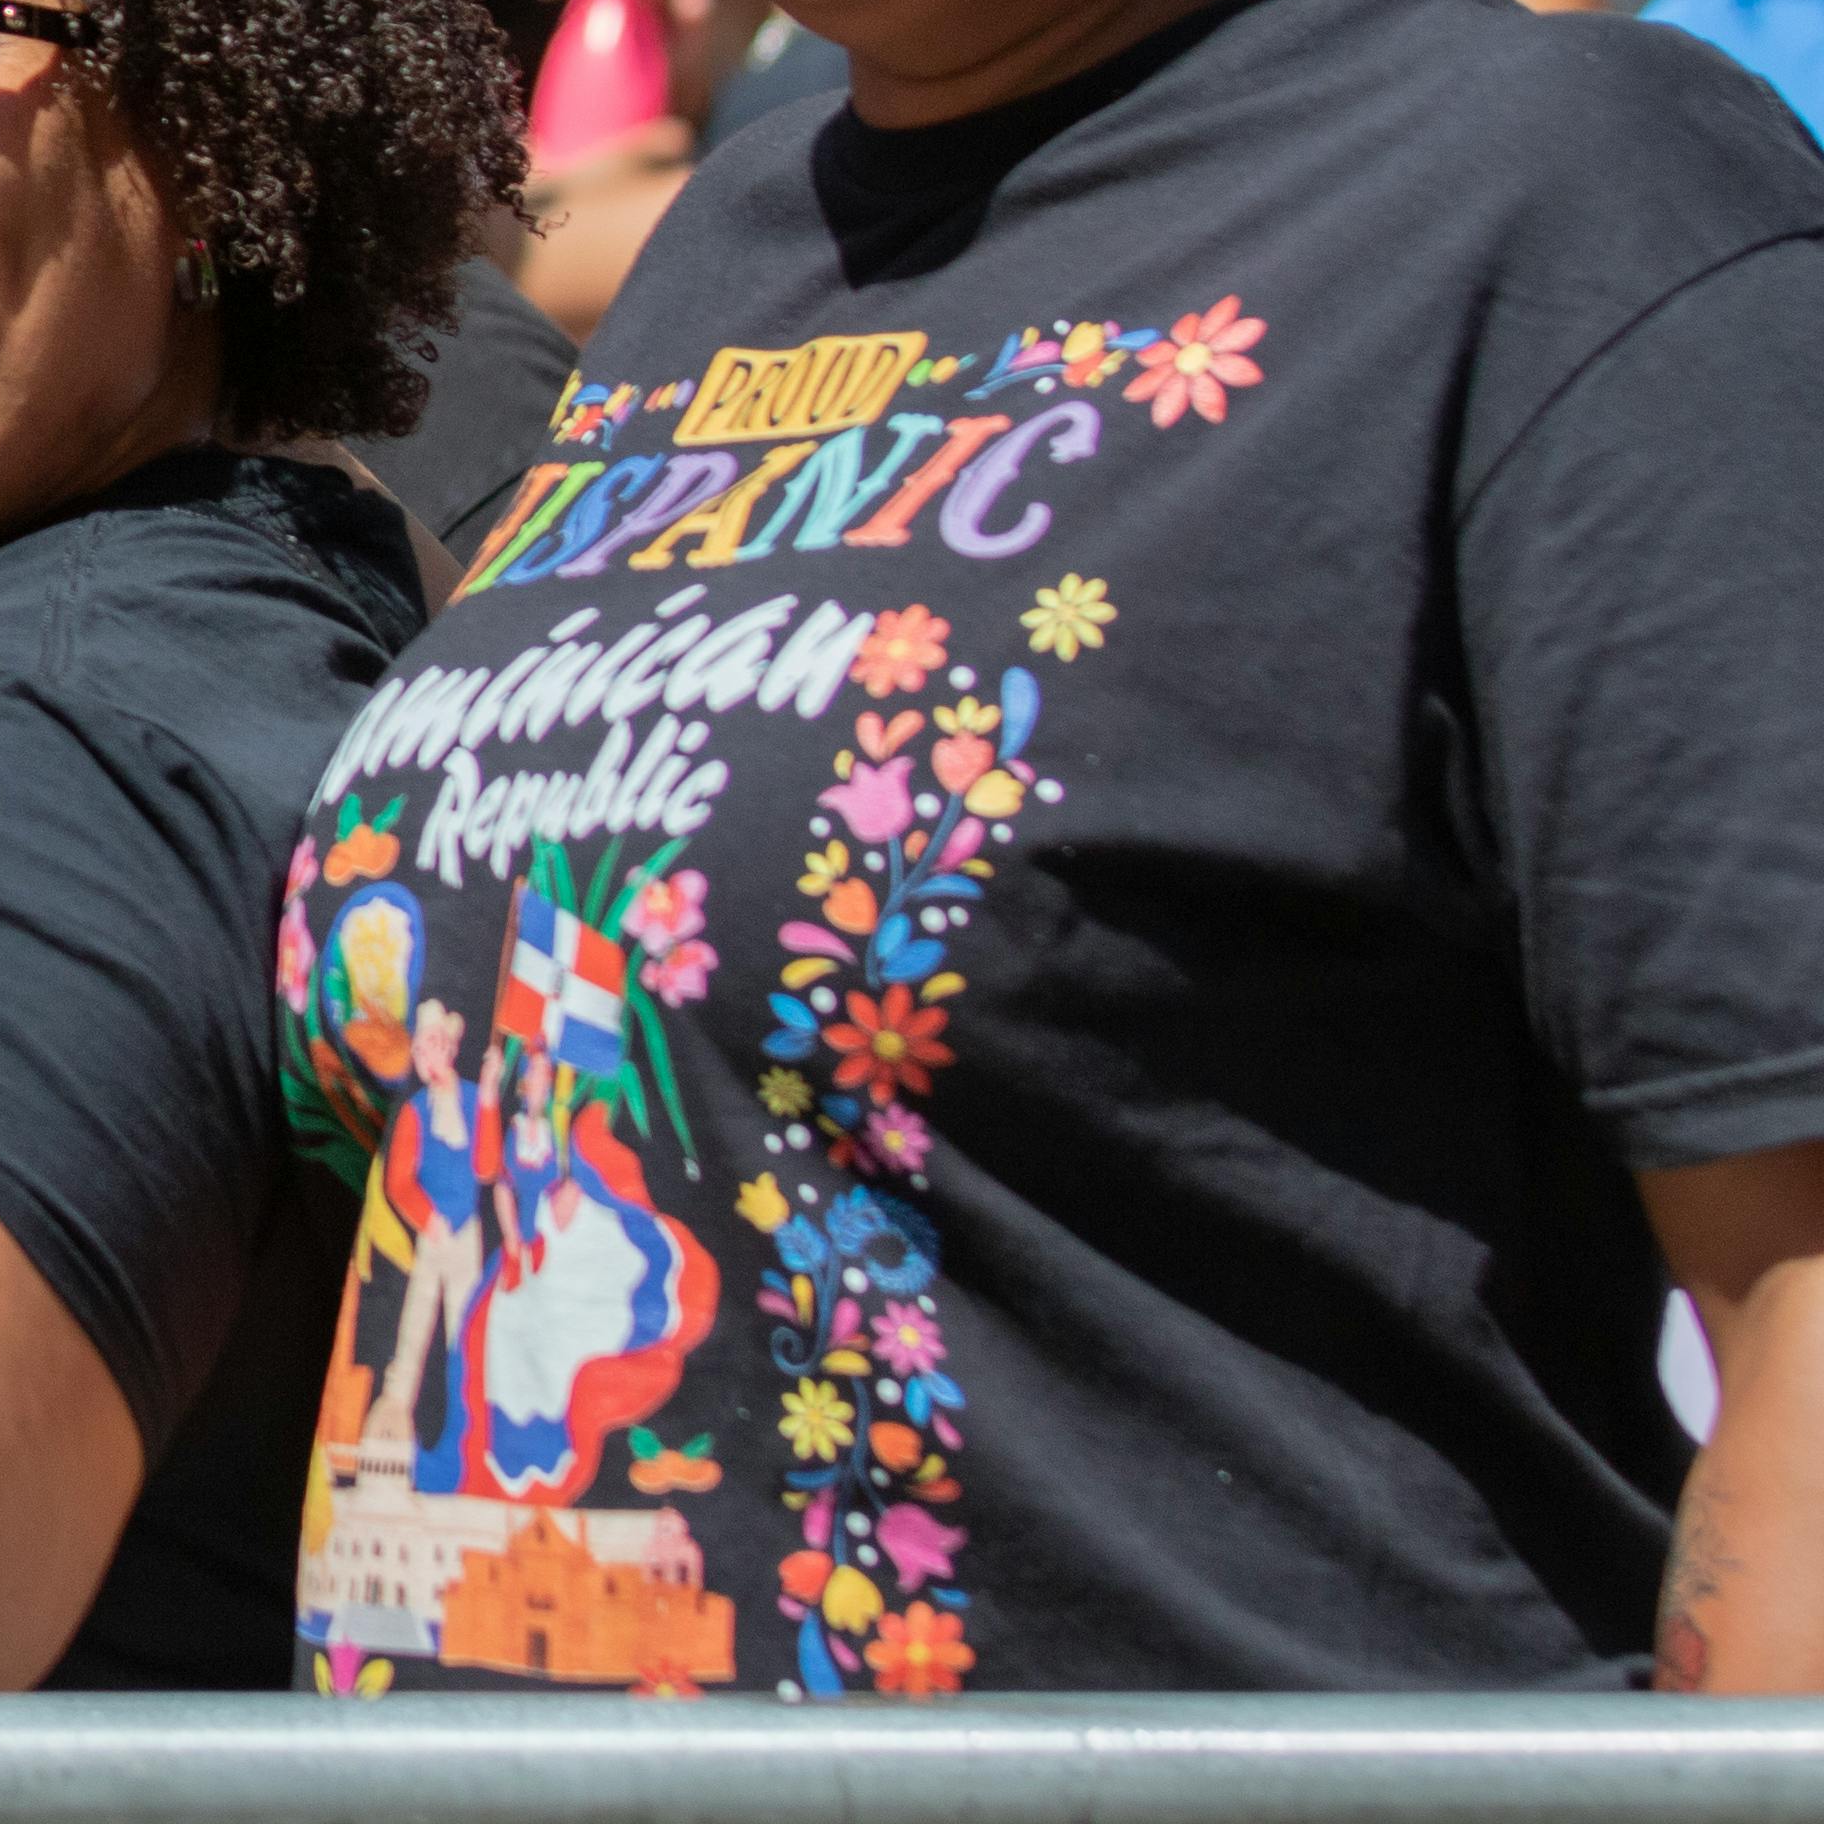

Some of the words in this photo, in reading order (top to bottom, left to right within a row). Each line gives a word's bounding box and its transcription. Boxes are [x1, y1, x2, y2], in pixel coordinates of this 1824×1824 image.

[689, 340, 902, 436] PROUD
[305, 583, 876, 818] ominican
[415, 713, 730, 889] Republic
